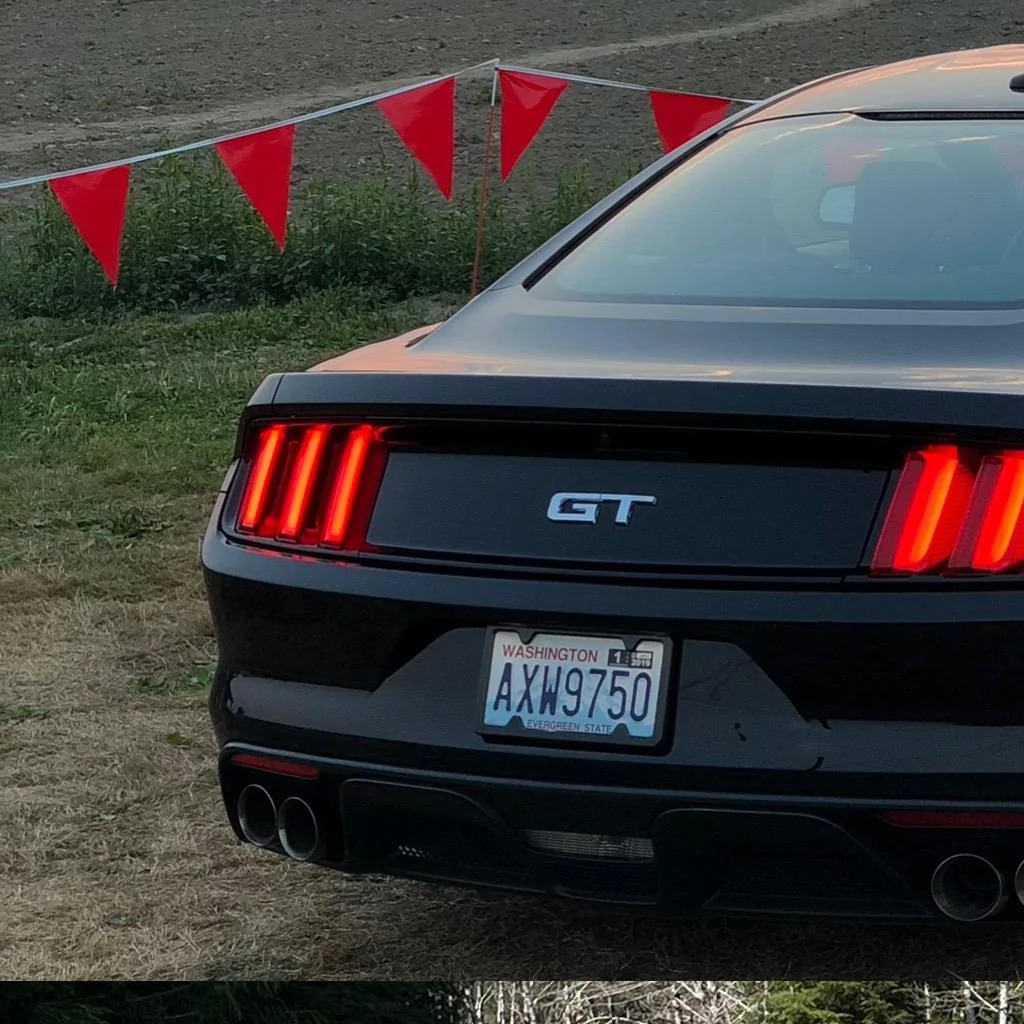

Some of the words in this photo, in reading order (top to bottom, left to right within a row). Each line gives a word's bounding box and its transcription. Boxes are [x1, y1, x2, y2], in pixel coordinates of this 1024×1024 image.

[547, 492, 657, 525] GT
[502, 644, 599, 663] WASHINGTON
[493, 662, 652, 722] AXW9750
[527, 719, 581, 732] EVERGREEN
[584, 724, 612, 735] STATE
